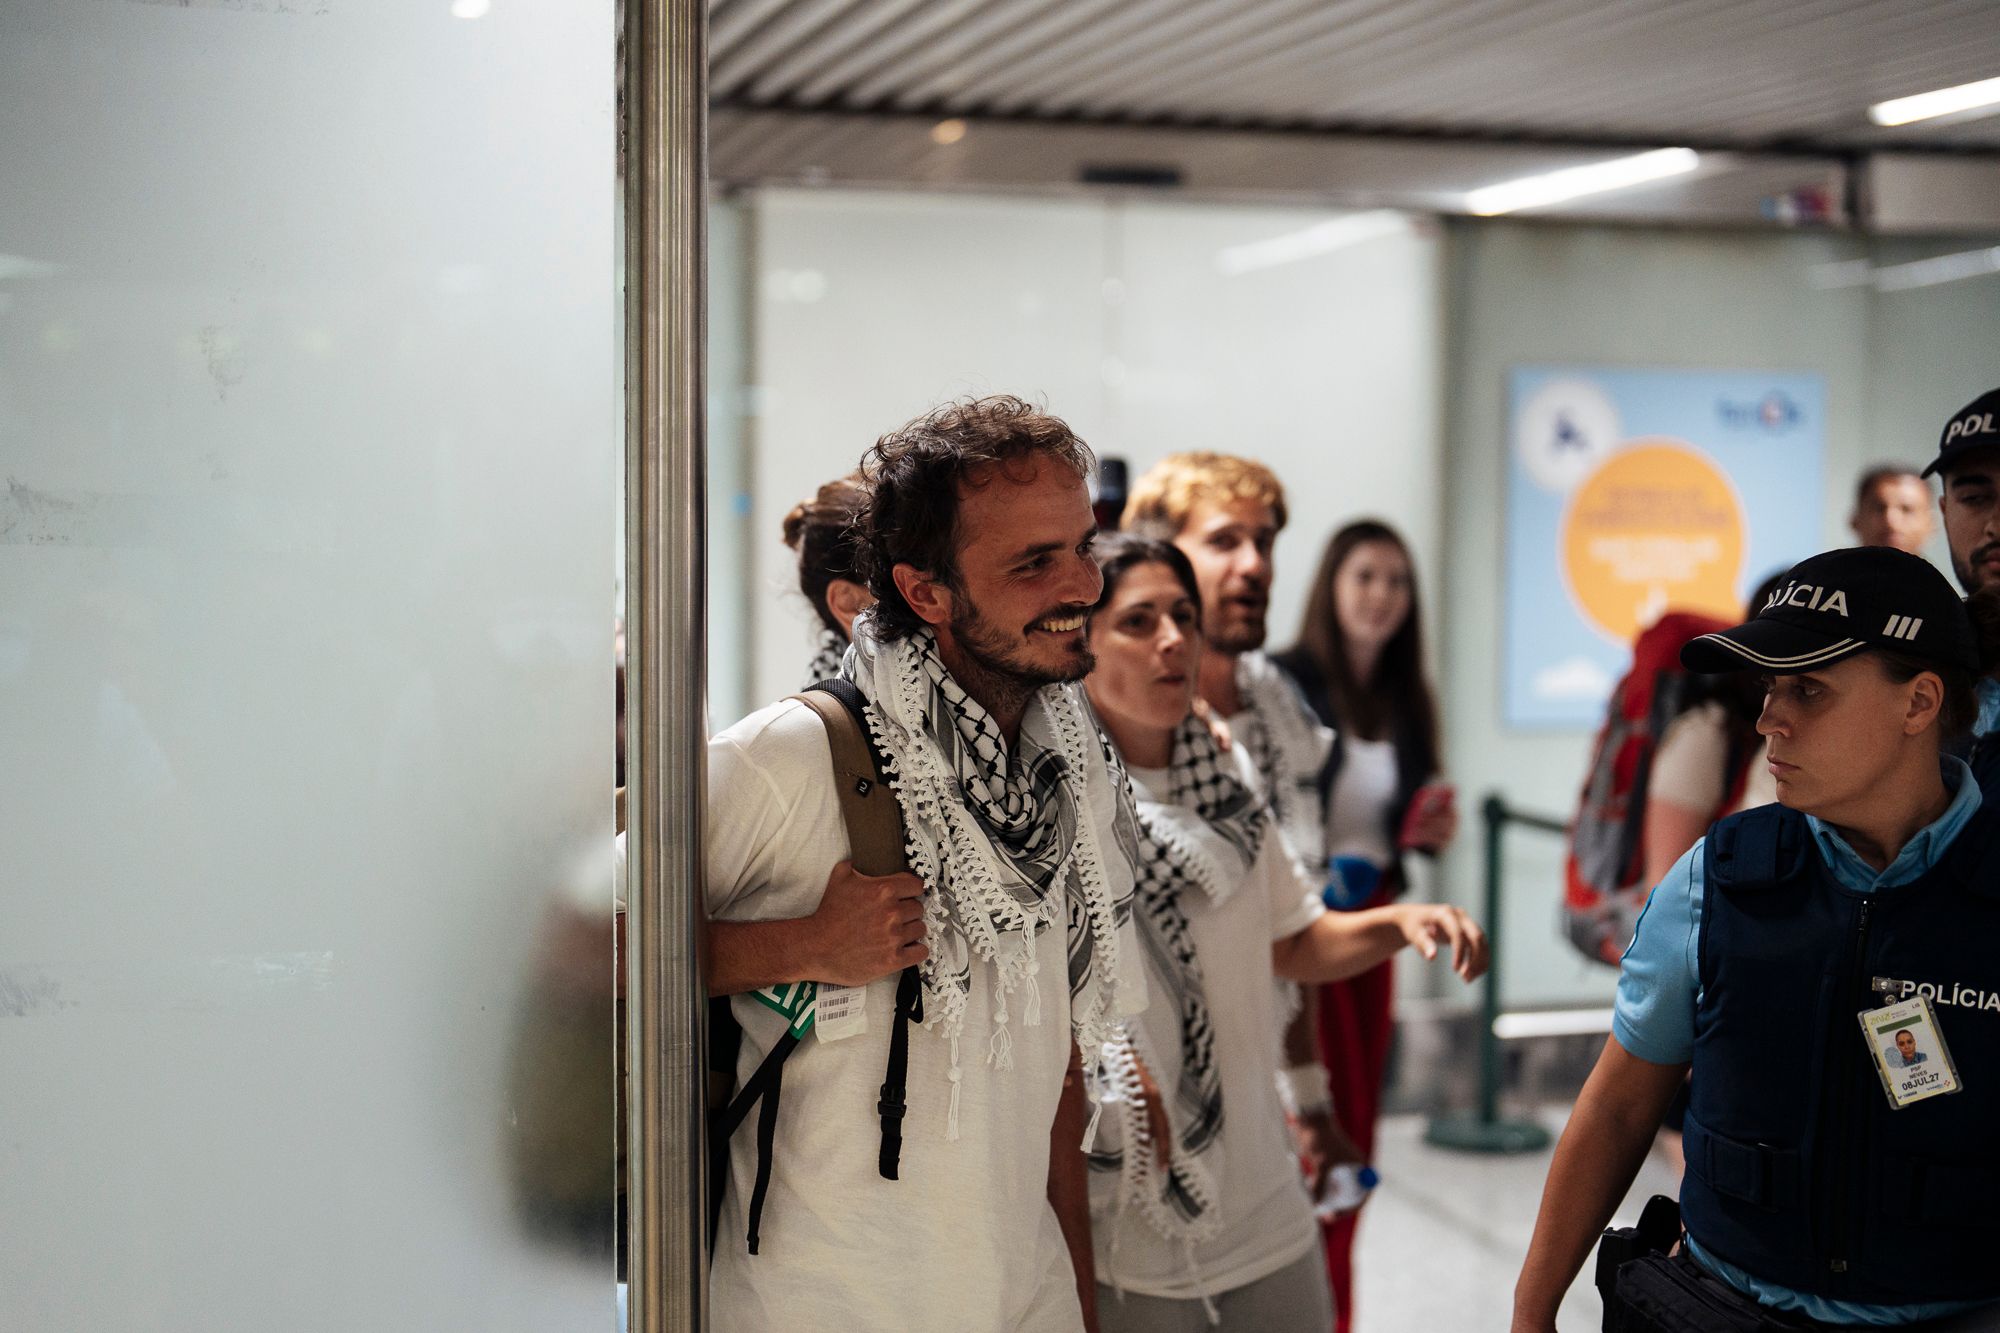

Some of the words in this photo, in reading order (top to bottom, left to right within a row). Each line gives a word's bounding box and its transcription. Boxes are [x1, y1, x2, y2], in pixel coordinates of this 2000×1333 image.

[1945, 413, 2000, 445] POL
[1760, 580, 1849, 617] LÍCIA
[1900, 980, 2000, 1012] POLÍCIA
